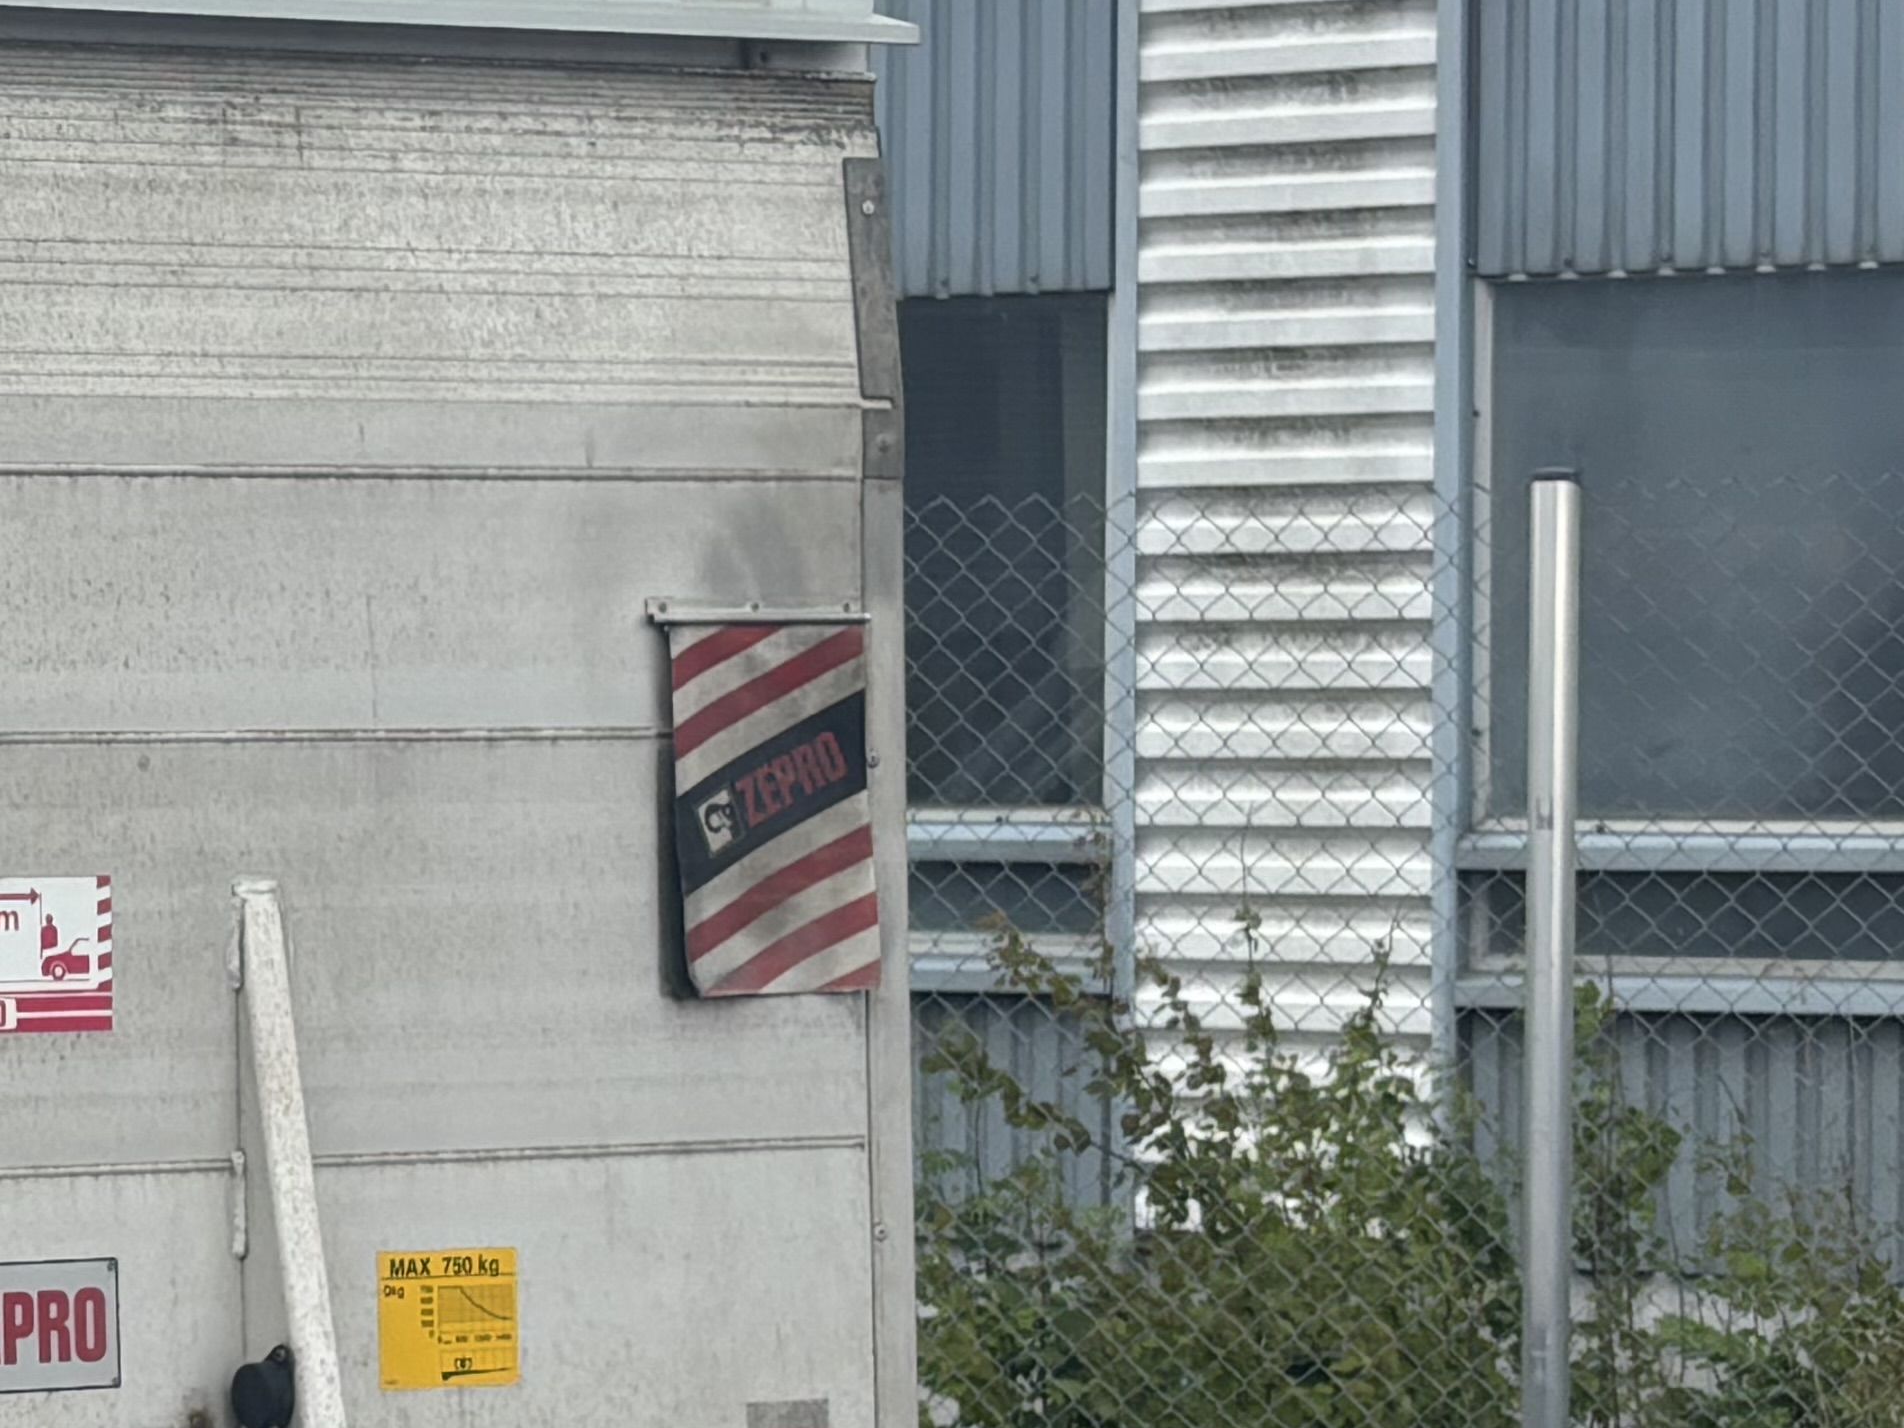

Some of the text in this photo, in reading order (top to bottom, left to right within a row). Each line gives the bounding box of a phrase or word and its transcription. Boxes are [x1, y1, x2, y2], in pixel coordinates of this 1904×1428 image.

[734, 731, 849, 829] ZEPRO
[389, 1254, 500, 1277] MAX 750 kg
